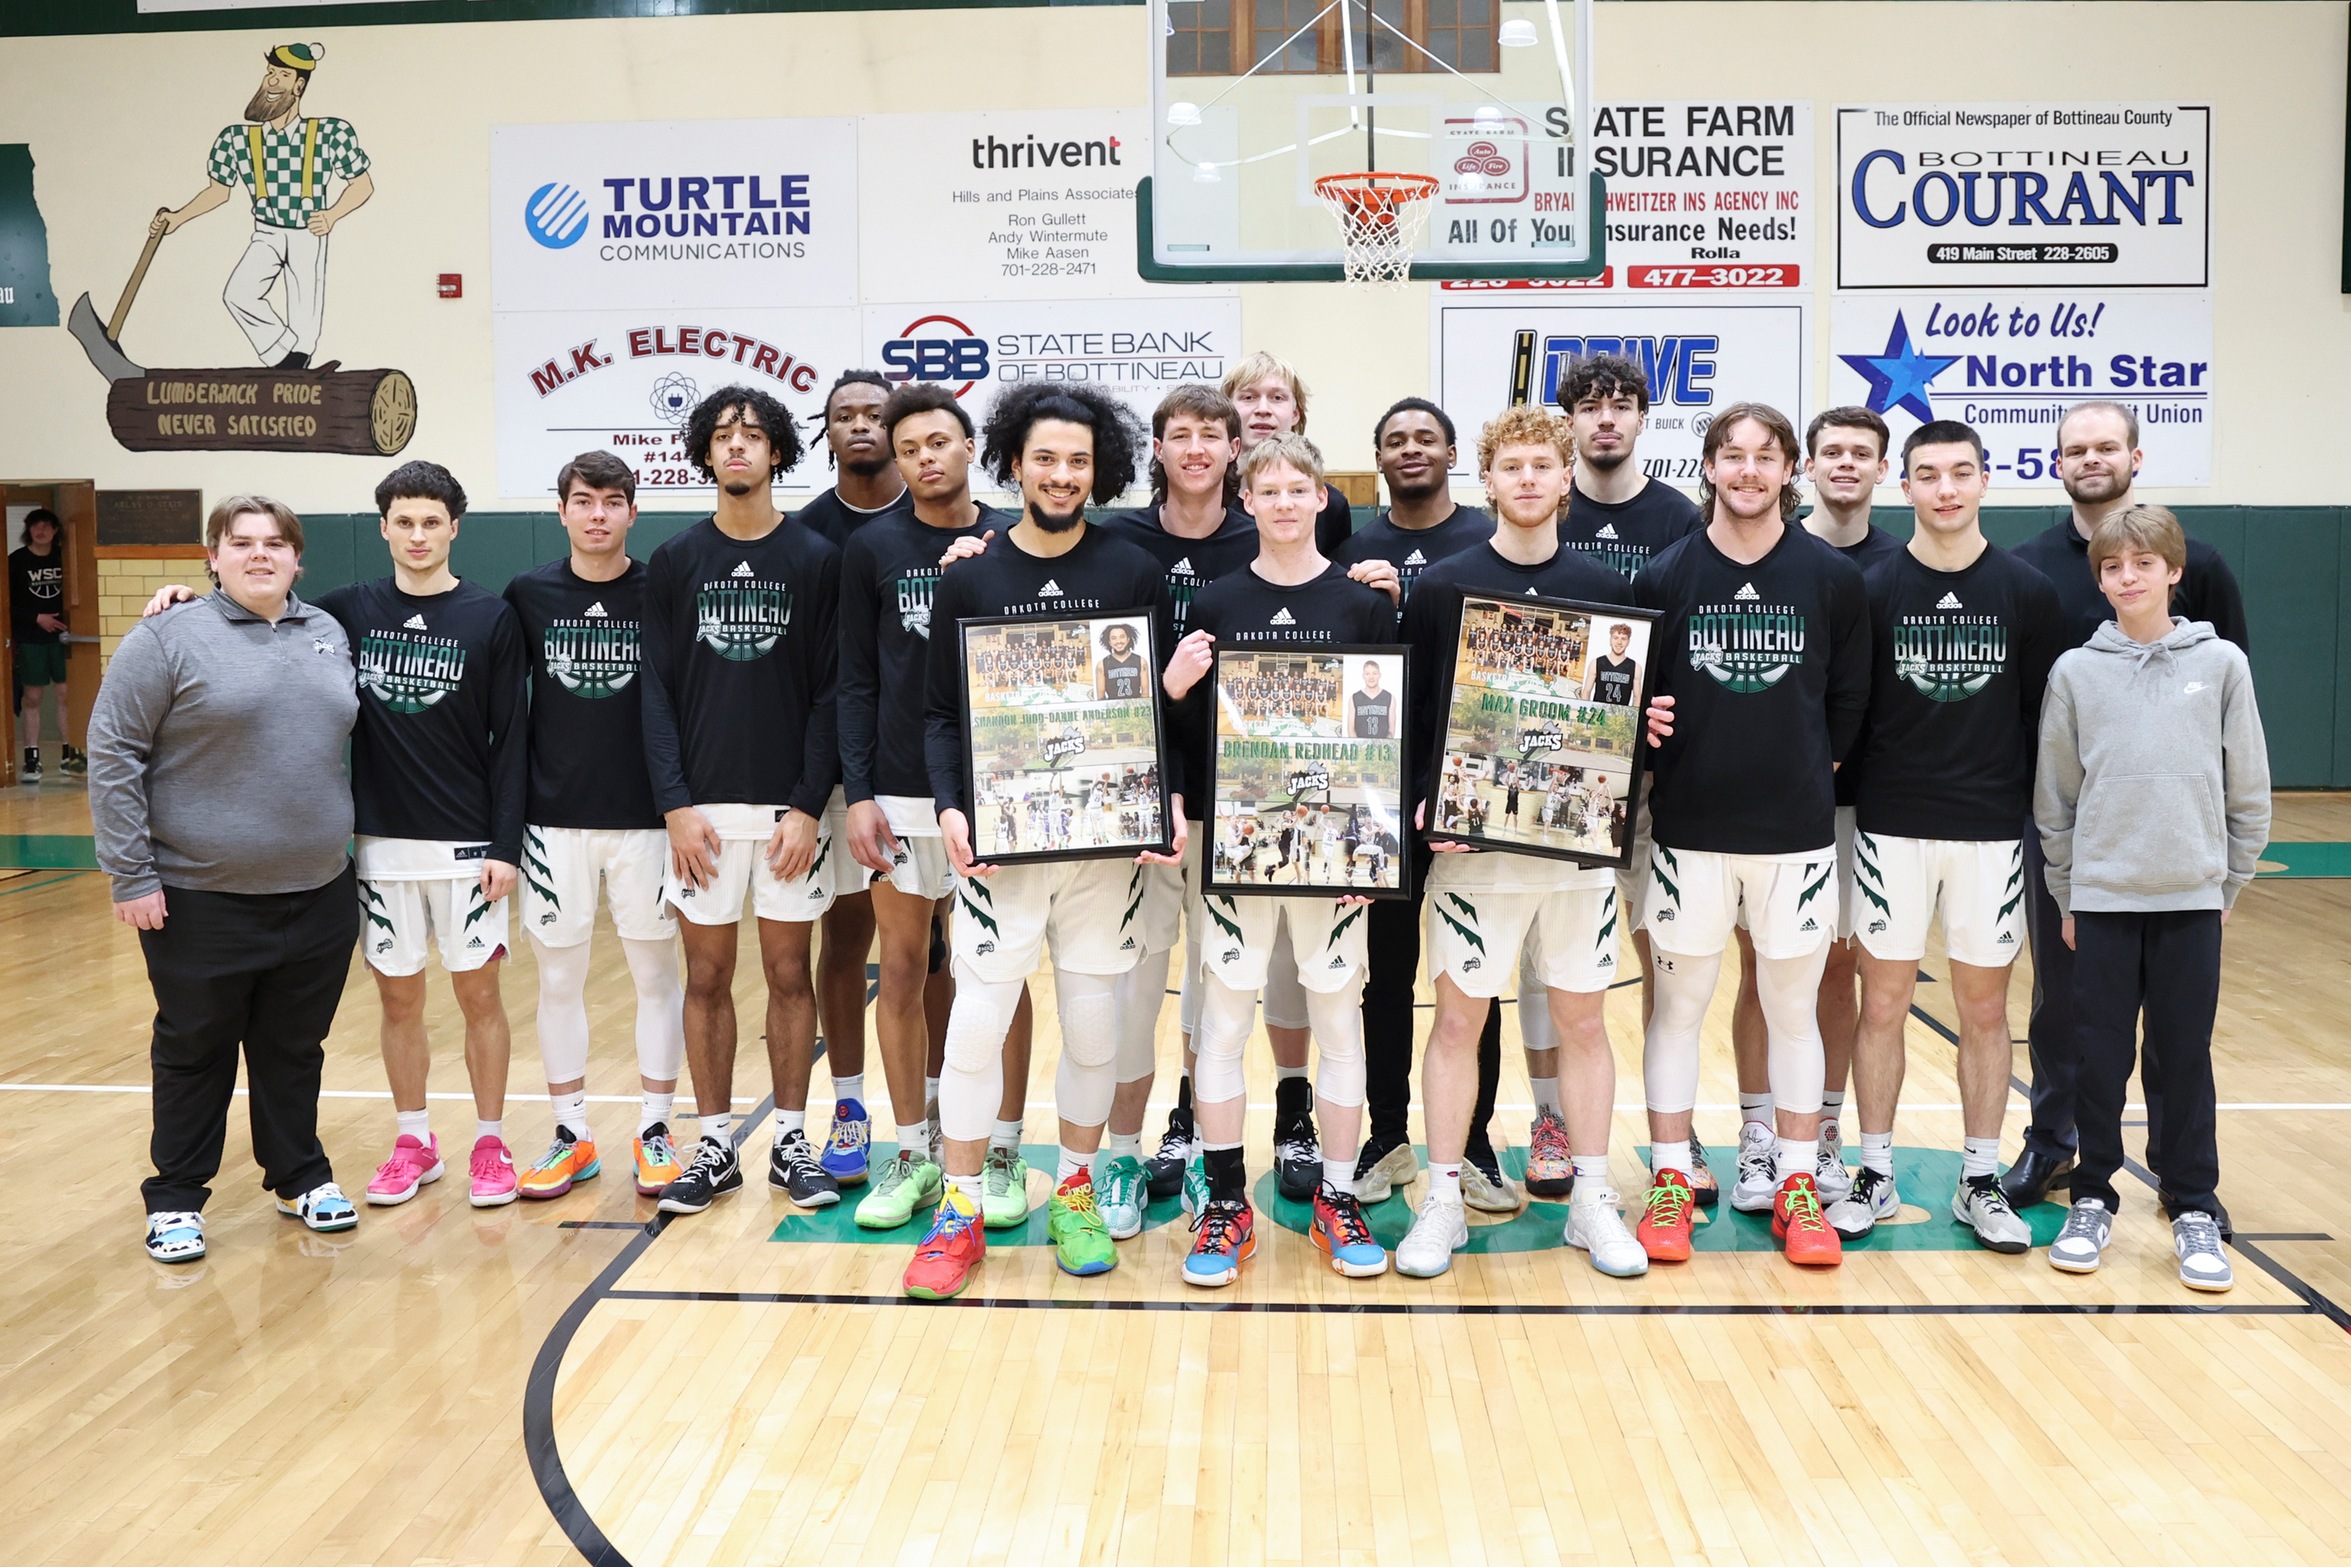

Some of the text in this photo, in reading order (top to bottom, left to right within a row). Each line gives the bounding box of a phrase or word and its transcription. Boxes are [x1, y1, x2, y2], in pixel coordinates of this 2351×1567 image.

[1546, 105, 1795, 138] SATE FARM
[1874, 110, 2173, 128] The Official Newspaper of Bottineau County
[973, 134, 1121, 169] thrivent
[1919, 150, 2189, 167] BOTTINEAU
[603, 174, 811, 212] TURTLE
[952, 190, 981, 204] Hills
[986, 189, 1013, 202] and
[1018, 188, 1059, 201] Plains
[1851, 149, 2195, 228] COURANT
[1605, 192, 1677, 212] HWEITZER
[1683, 192, 1706, 212] INS
[1713, 191, 1769, 212] AGENCY
[1776, 190, 1799, 211] INC
[603, 211, 811, 239] MOUNTAIN
[1008, 213, 1086, 226] Ron Gullett
[988, 229, 1108, 246] Andy Wintermute
[1448, 219, 1478, 244] All
[1491, 218, 1518, 243] Of
[1605, 219, 1706, 243] nsurance
[1718, 217, 1796, 242] Needs!
[600, 242, 806, 262] COMMUNICATIONS
[1007, 246, 1089, 260] Mike Aasen
[1690, 246, 1741, 260] Rolla
[1936, 246, 2110, 261] 419 Main Street 228-2605
[1001, 262, 1096, 277] 701-228-2471
[1925, 302, 2105, 338] Look to Us!
[997, 331, 1214, 355] STATE BANK
[527, 325, 818, 399] M.K. ELECTRIC
[881, 338, 990, 382] SBB
[998, 360, 1224, 383] OF BOTTINEAU
[1966, 353, 2208, 388] North Star
[147, 382, 322, 405] LUMBERJACK PRIDE
[2146, 403, 2203, 424] Union
[157, 414, 317, 437] NEVER SATISFIED
[1655, 418, 1685, 430] BUICK
[613, 434, 662, 446] Mike
[1595, 531, 1619, 540] adidas
[1607, 543, 1651, 555] COLLEGE
[1404, 558, 1427, 566] adidas
[27, 567, 63, 581] WSC
[731, 570, 754, 578] adidas
[1170, 567, 1195, 576] adidas
[744, 580, 786, 592] COLLEGE
[1038, 588, 1064, 598] adidas
[696, 590, 793, 626] BOTTINEAU
[1003, 599, 1100, 616] DAKOTA COLLEGE
[1699, 604, 1795, 615] DAKOTA COLLEGE
[403, 622, 427, 630] adidas
[553, 619, 640, 629] DAKOTA COLLEGE
[1270, 616, 1296, 625] adidas
[1903, 616, 1998, 626] DAKOTA COLLEGE
[370, 629, 459, 647] DAKOTA COLLEGE
[1236, 629, 1332, 641] DAKOTA COLLEGE
[1689, 614, 1805, 652] BOTTINEAU
[1893, 626, 2007, 662] BOTTINEAU
[359, 637, 466, 682] BOTTINEAU
[573, 662, 641, 672] BASKETBAL
[1691, 651, 1801, 666] JACKS BASKETBALL
[1929, 663, 2003, 674] BASKETBALL
[387, 675, 458, 692] BASKETBALL
[1116, 678, 1133, 697] 23
[1605, 683, 1622, 702] 24
[1082, 707, 1130, 721] ANDERSON
[1133, 706, 1152, 717] #23
[1482, 694, 1606, 726] MAX GROOM #24
[1366, 716, 1379, 735] 13
[1043, 736, 1086, 762] JACKS
[1519, 731, 1563, 752] JACKS
[1224, 741, 1392, 761] BRENDAN REDHEAD #13
[1287, 772, 1329, 796] JACKS
